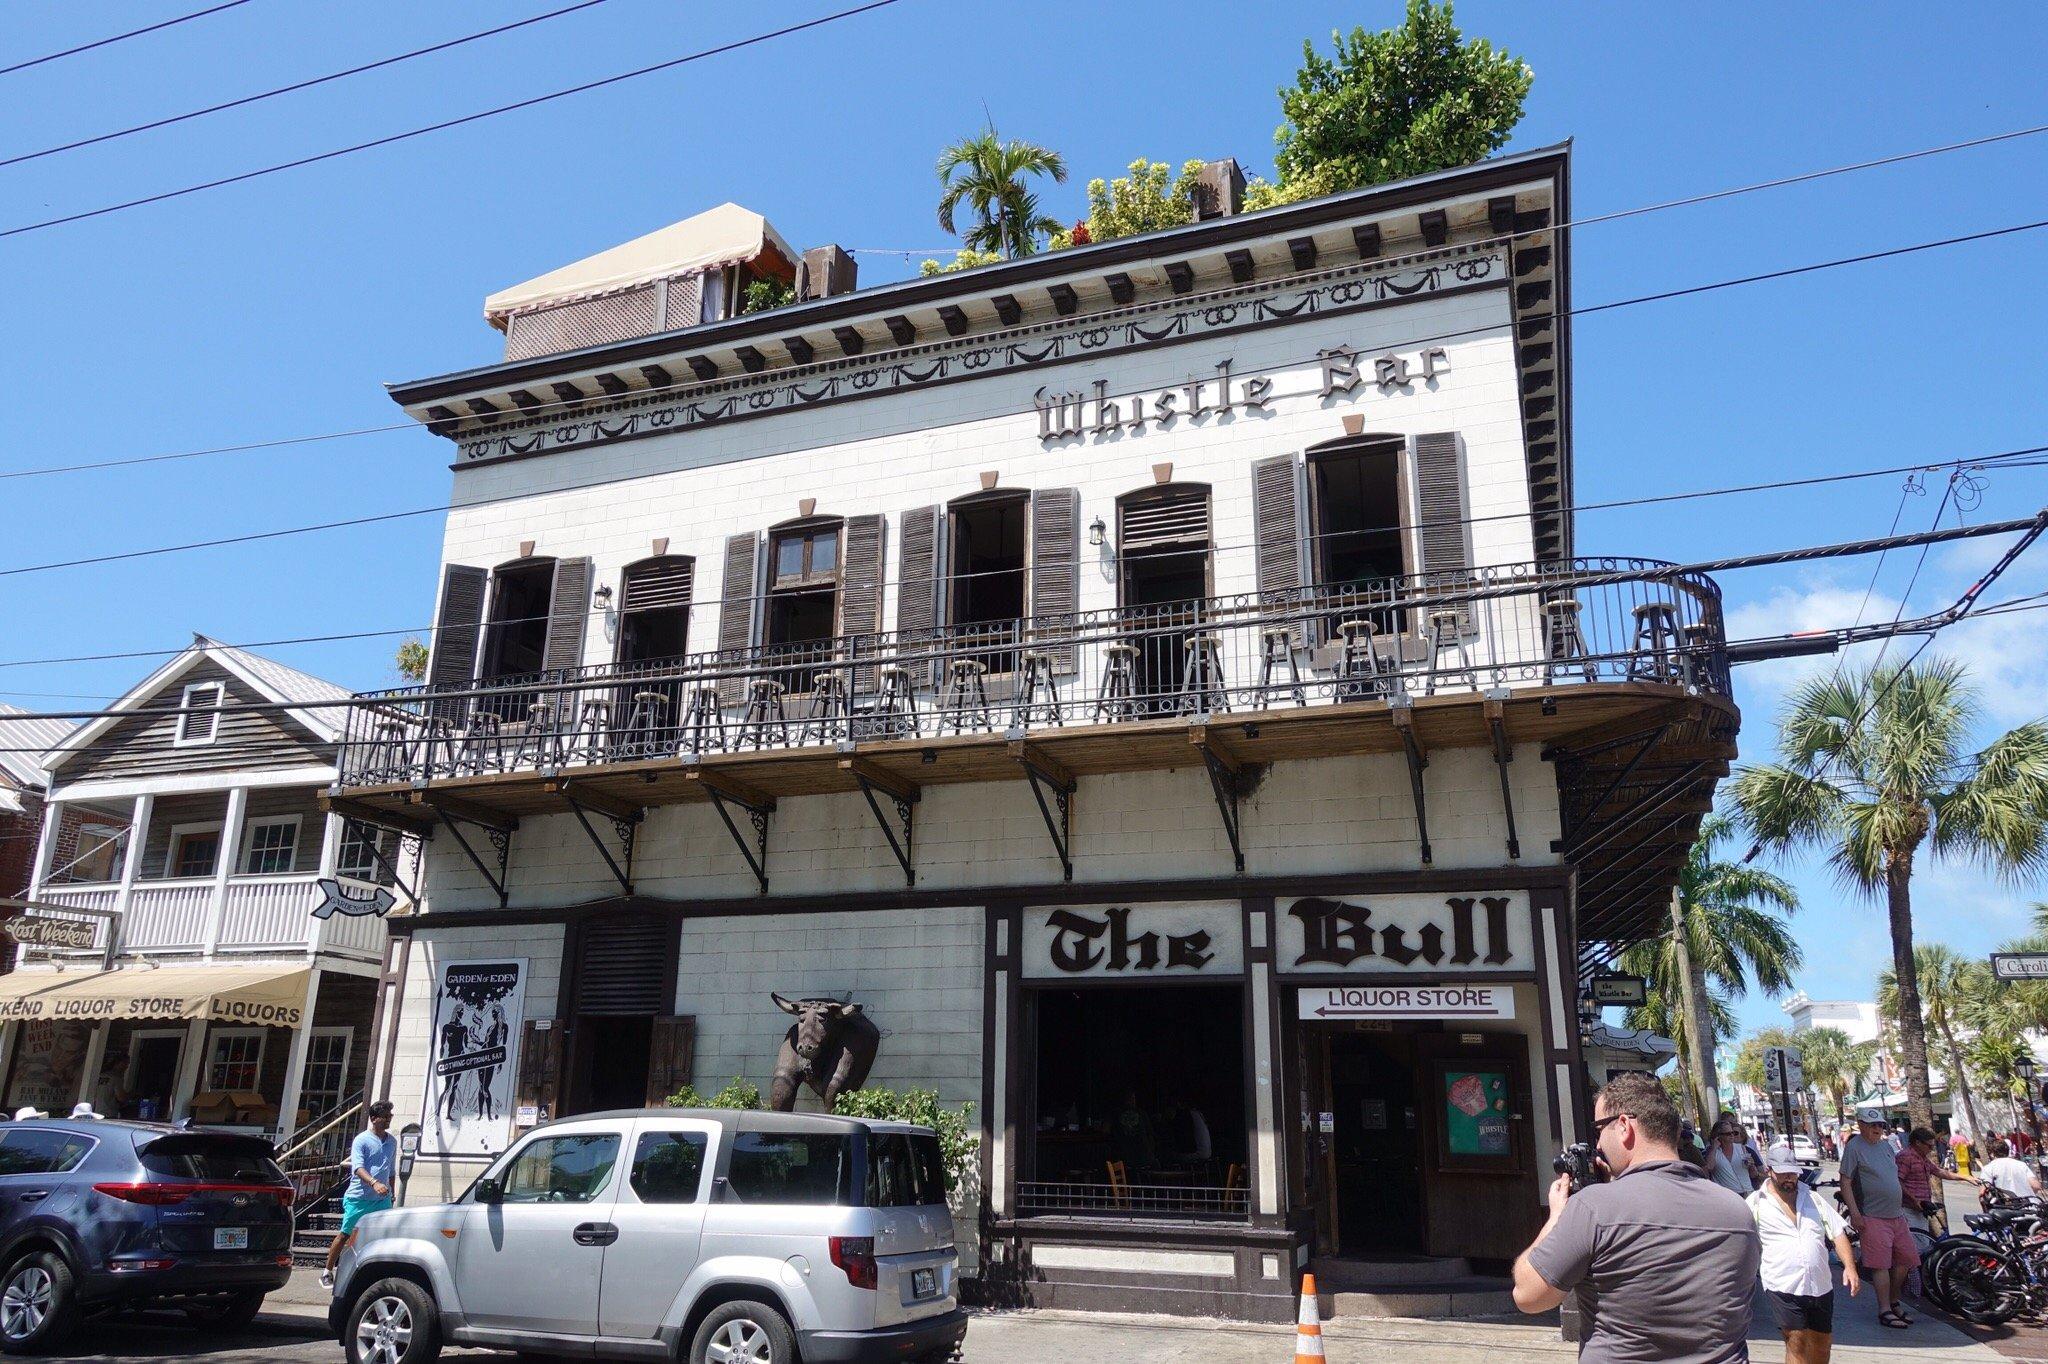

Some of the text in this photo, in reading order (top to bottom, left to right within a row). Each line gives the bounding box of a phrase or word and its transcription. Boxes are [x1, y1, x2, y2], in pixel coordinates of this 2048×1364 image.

[1034, 343, 1449, 441] Whistle Bar
[330, 896, 359, 912] GARDEN
[363, 901, 384, 912] EDEN
[5, 916, 97, 948] Lost Weekend
[1044, 897, 1514, 972] The Bull
[447, 974, 483, 984] GARDEN
[490, 973, 516, 983] EDEN
[55, 1000, 116, 1014] LIQUOR
[129, 998, 183, 1013] STORE
[1328, 988, 1493, 1007] LIQUOR STORE
[212, 999, 300, 1023] LIQUORS
[1479, 1124, 1509, 1136] WHISTLE
